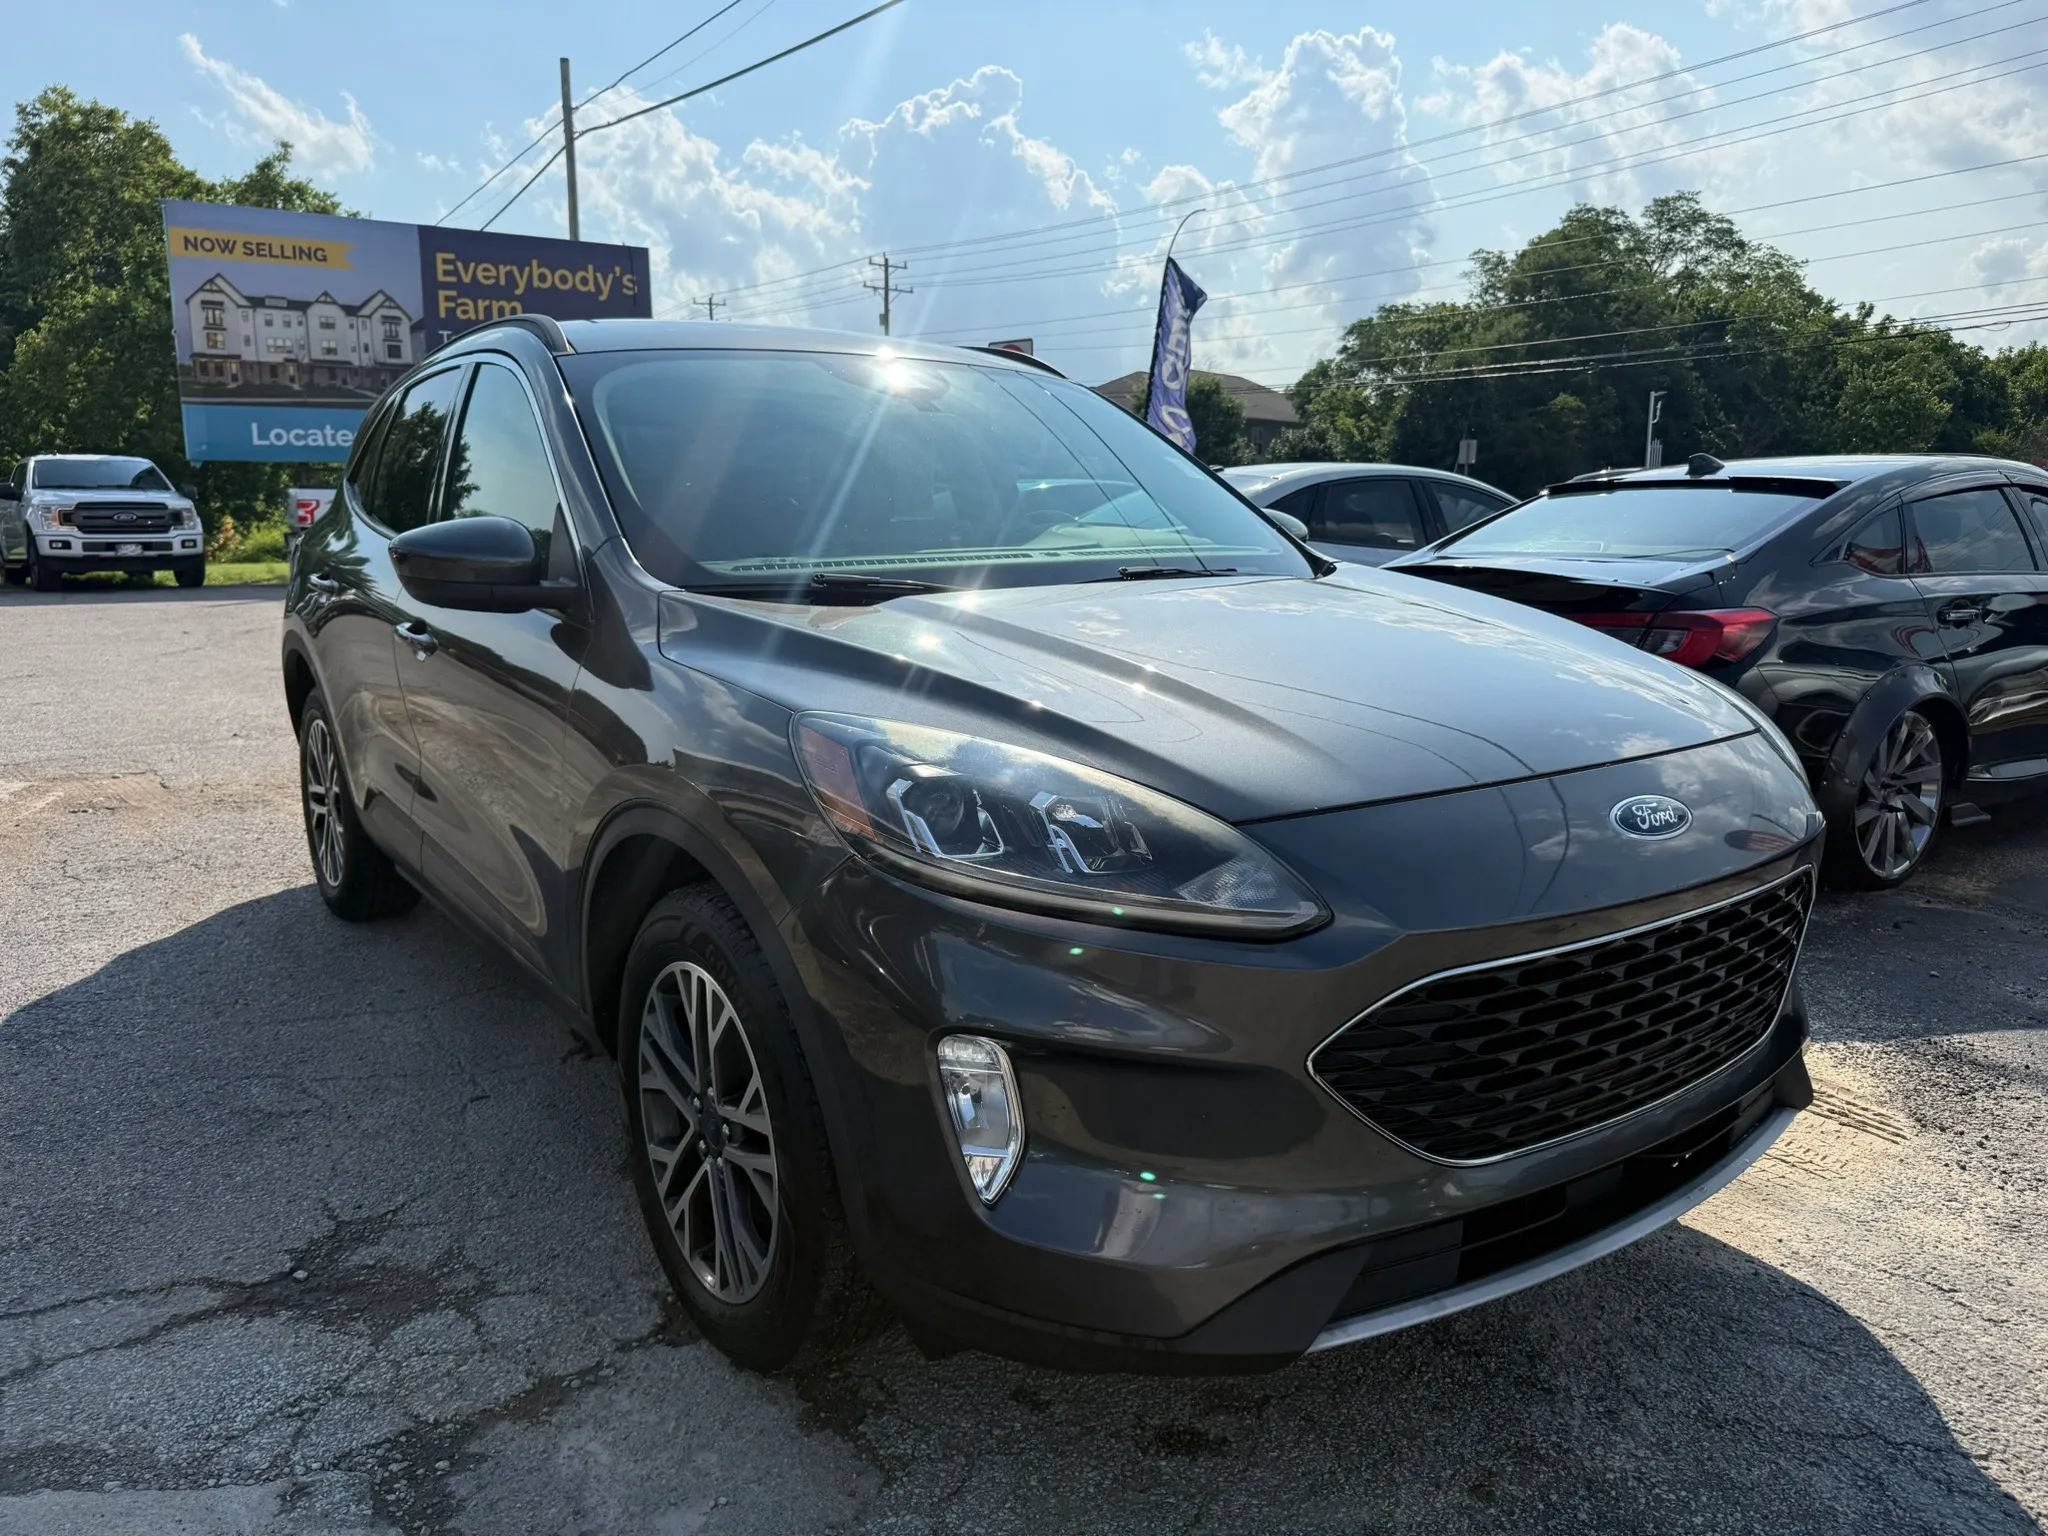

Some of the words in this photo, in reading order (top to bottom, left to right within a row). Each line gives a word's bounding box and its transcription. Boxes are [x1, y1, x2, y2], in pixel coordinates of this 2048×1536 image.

[183, 235, 237, 255] NOW
[242, 241, 328, 262] SELLING
[435, 252, 637, 301] Everybody's
[438, 290, 523, 320] Farm
[251, 422, 357, 446] Locate
[1631, 802, 1678, 829] Ford
